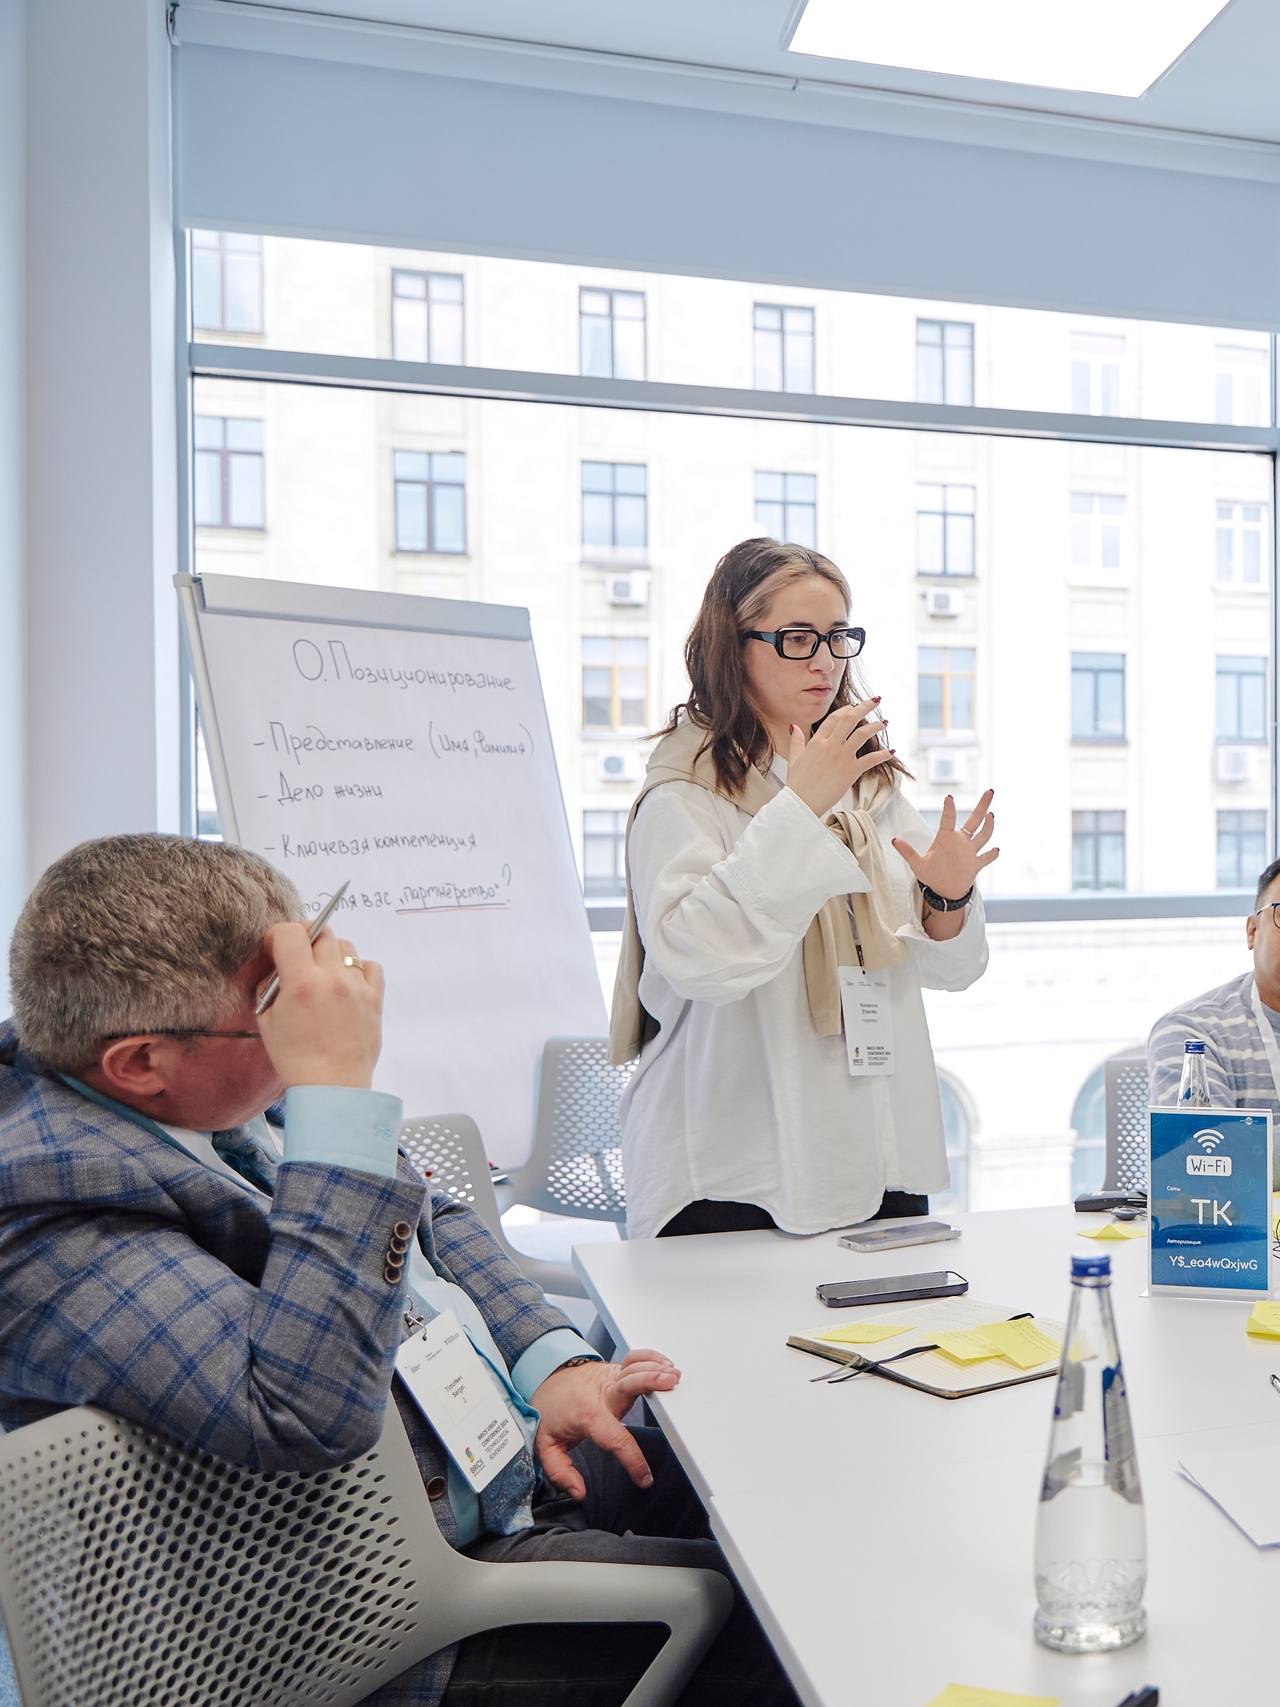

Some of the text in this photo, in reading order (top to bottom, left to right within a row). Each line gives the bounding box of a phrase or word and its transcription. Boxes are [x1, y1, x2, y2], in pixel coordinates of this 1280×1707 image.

[269, 721, 415, 766] Представление
[277, 770, 324, 807] Дело
[333, 783, 384, 800] жизни
[282, 833, 371, 859] Ключевая
[373, 832, 477, 854] компетенция
[362, 891, 392, 908] вас
[1190, 1158, 1227, 1174] Wi-Fi
[477, 1419, 497, 1440] BRICS VISION
[481, 1426, 501, 1447] CONFERENCE
[470, 1458, 484, 1474] BRICS
